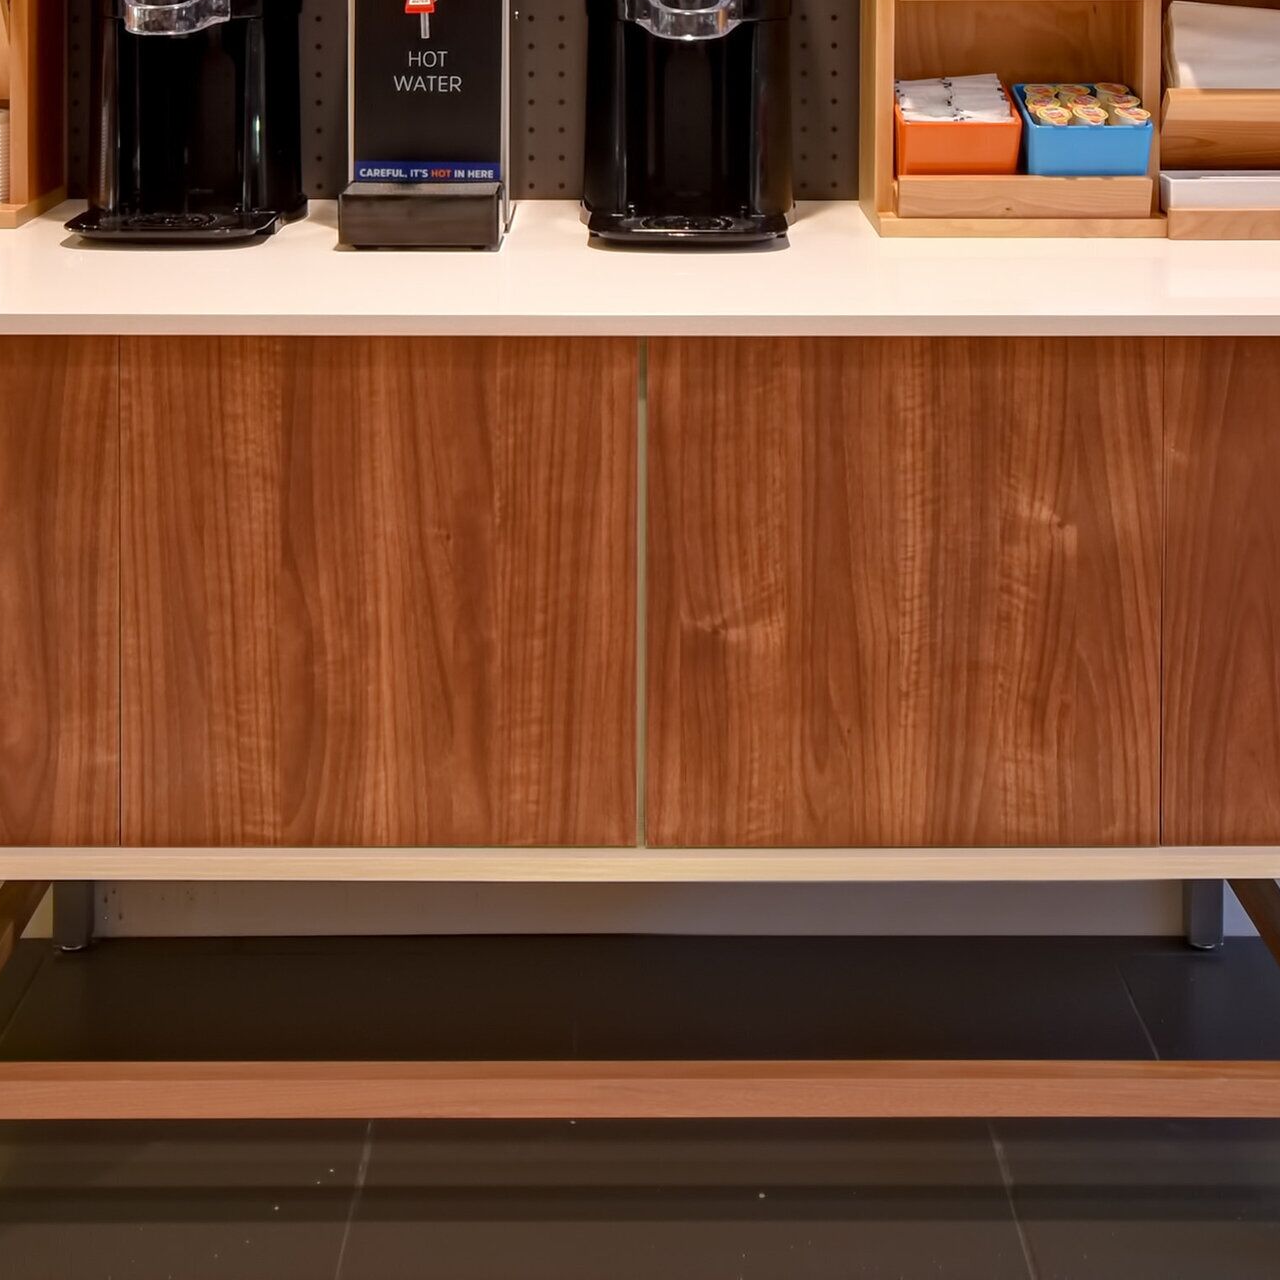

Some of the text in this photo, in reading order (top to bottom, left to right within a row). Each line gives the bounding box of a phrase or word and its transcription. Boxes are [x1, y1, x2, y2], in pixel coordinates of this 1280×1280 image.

[408, 51, 448, 67] HOT
[393, 75, 462, 92] WATER
[410, 169, 428, 178] IT'S
[431, 169, 451, 178] HOT
[454, 170, 464, 178] IN
[468, 170, 494, 178] HERE
